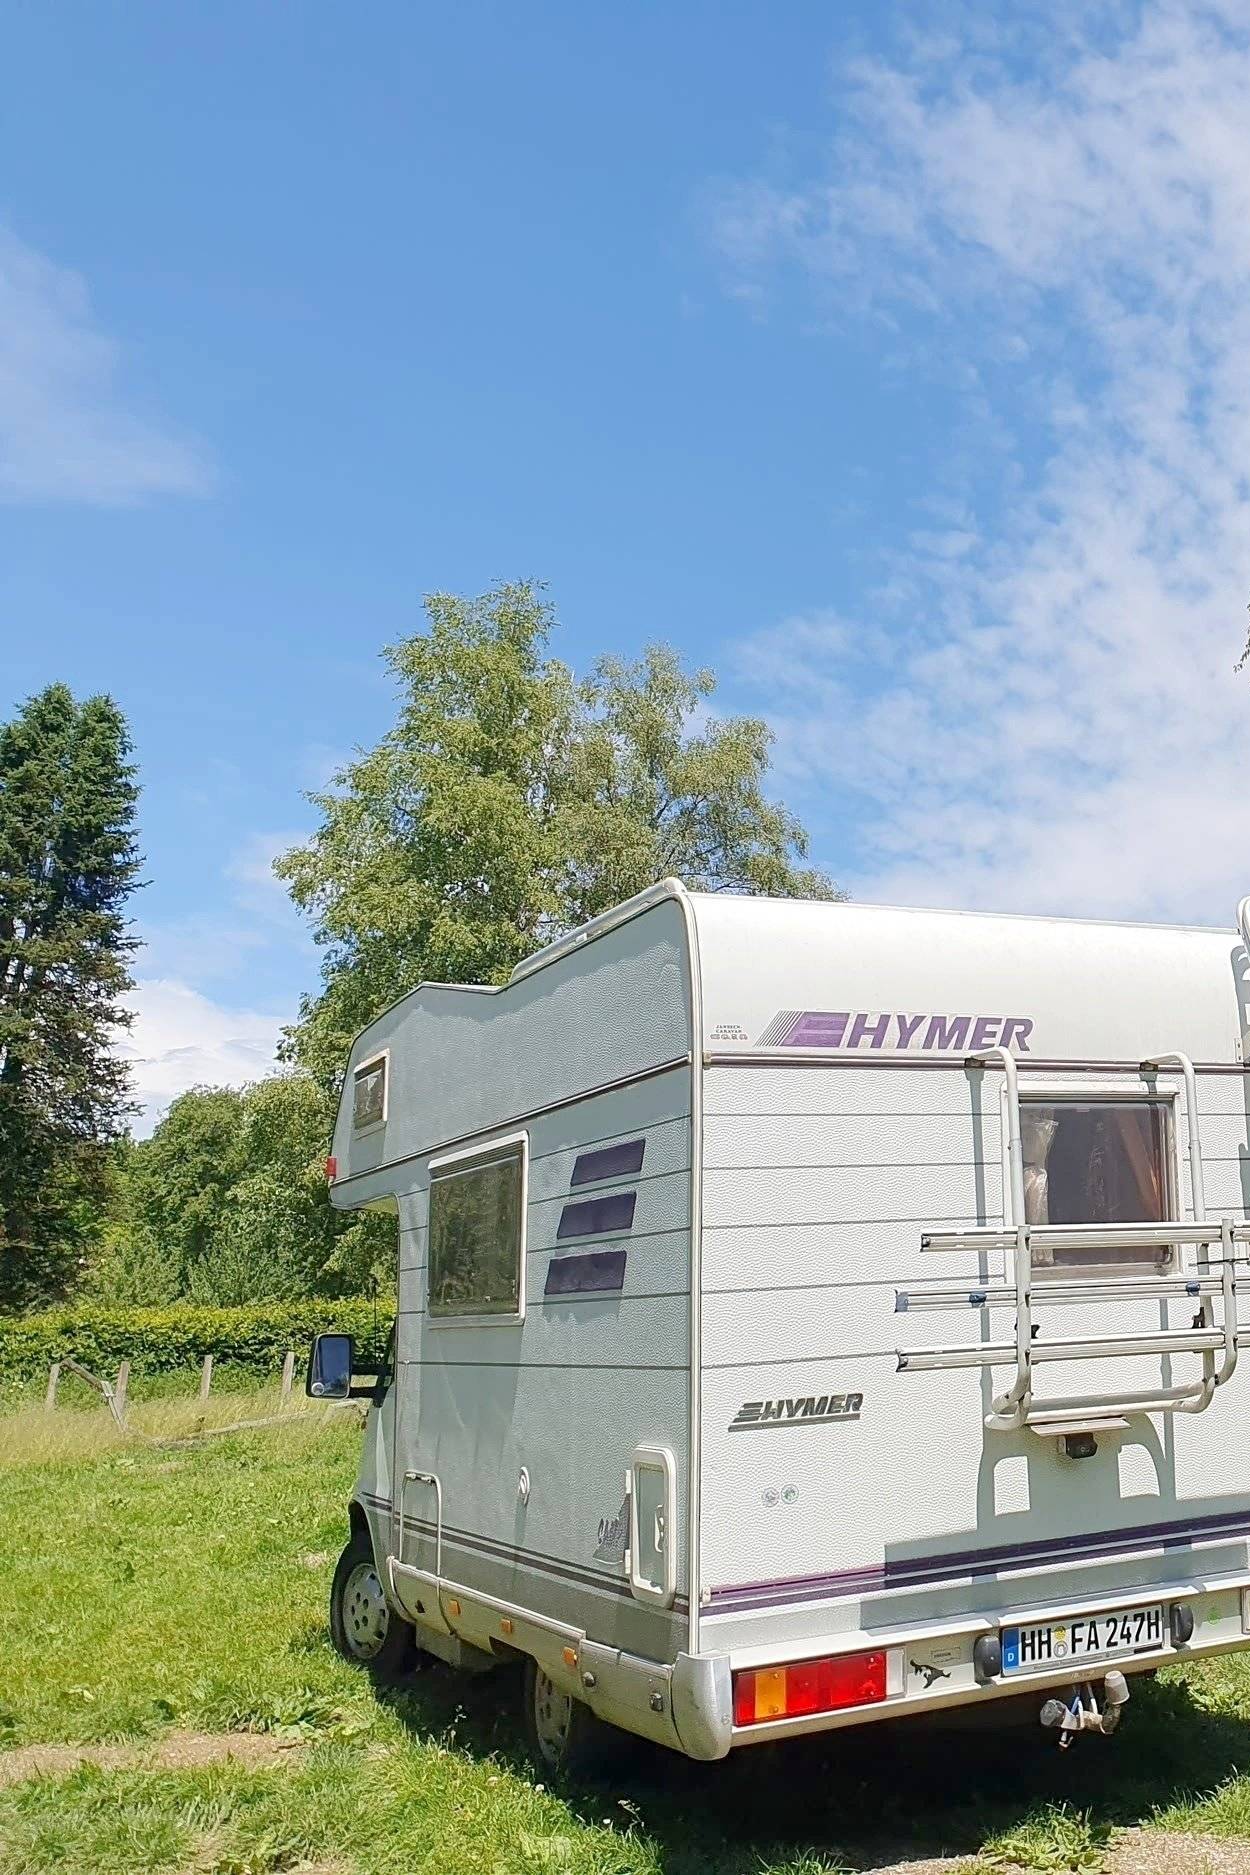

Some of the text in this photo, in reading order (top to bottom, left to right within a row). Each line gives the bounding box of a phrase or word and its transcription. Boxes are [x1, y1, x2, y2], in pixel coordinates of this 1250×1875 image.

[846, 1013, 1034, 1051] HYMER
[760, 1392, 864, 1421] HYMER
[1007, 1653, 1015, 1662] D
[1020, 1627, 1052, 1662] HH
[1071, 1620, 1100, 1654] FA
[1105, 1609, 1160, 1648] 247H
